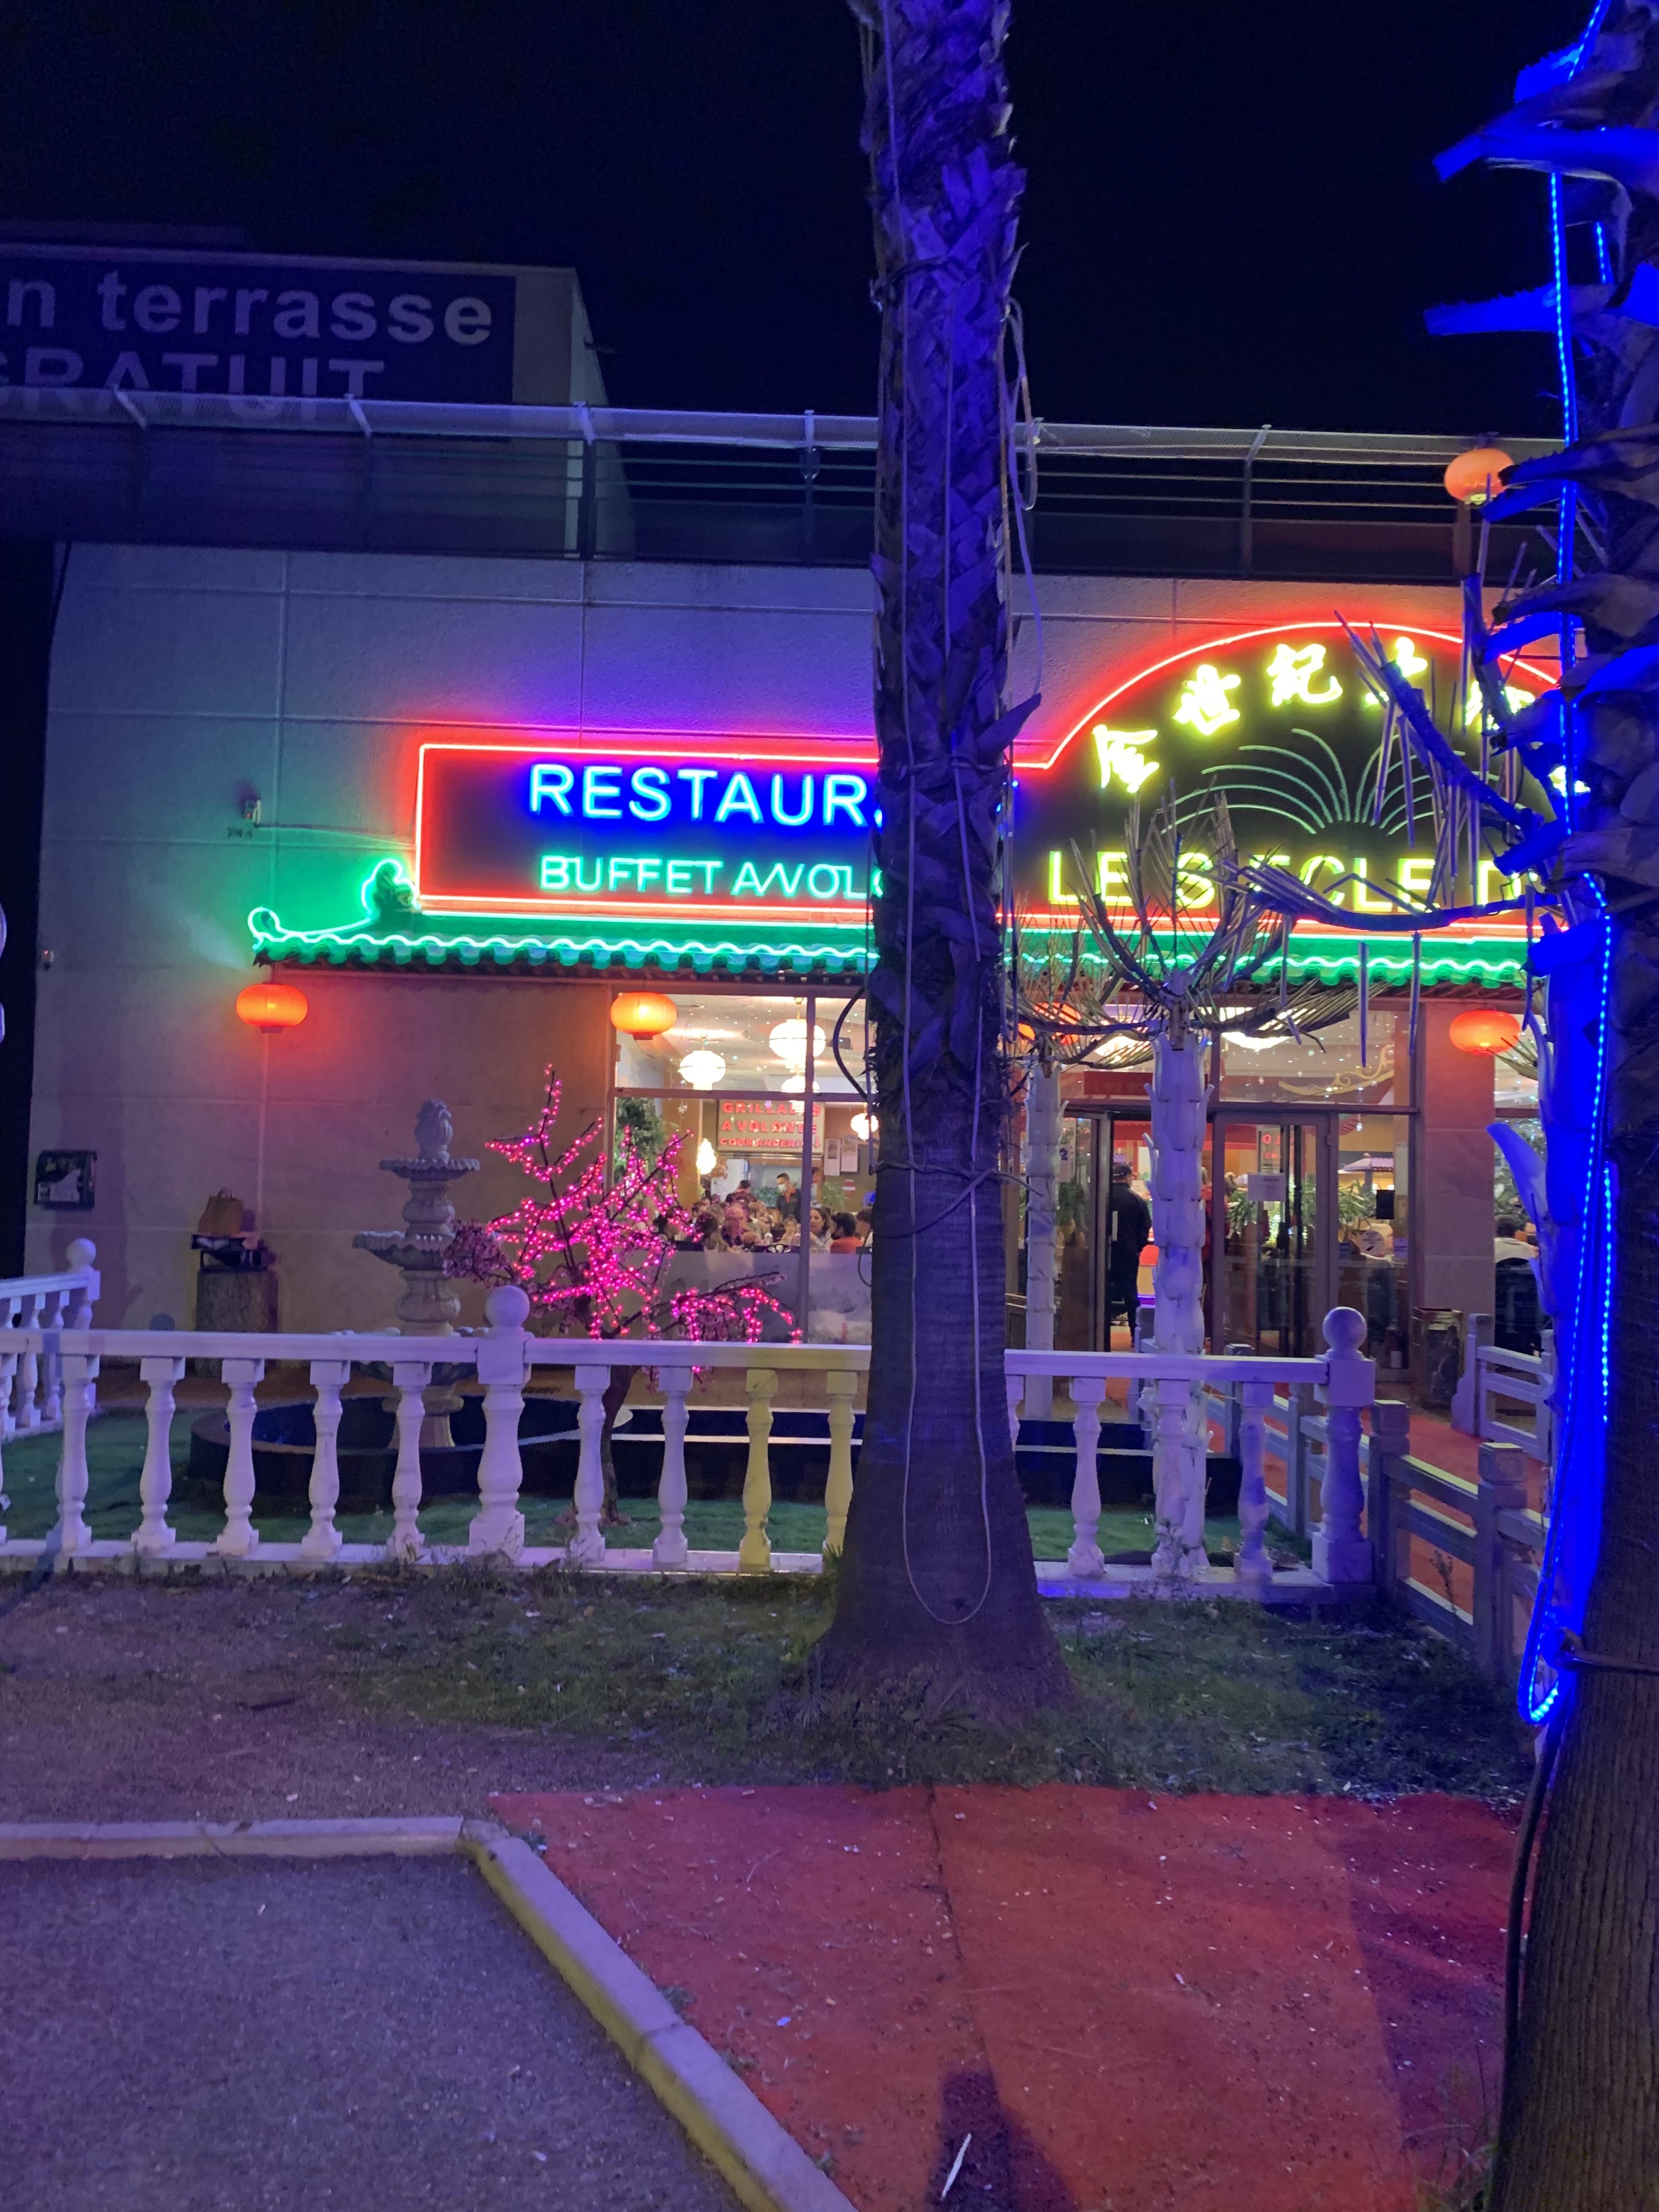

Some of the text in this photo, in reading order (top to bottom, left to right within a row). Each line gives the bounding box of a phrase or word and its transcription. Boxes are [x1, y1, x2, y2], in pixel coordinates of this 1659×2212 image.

[98, 269, 492, 346] terrasse
[0, 346, 385, 421] RATUIT
[530, 763, 883, 827] RESTAUR
[540, 856, 723, 894] BUFFET
[1048, 850, 1133, 906] LE
[1176, 851, 1441, 914] SCLE
